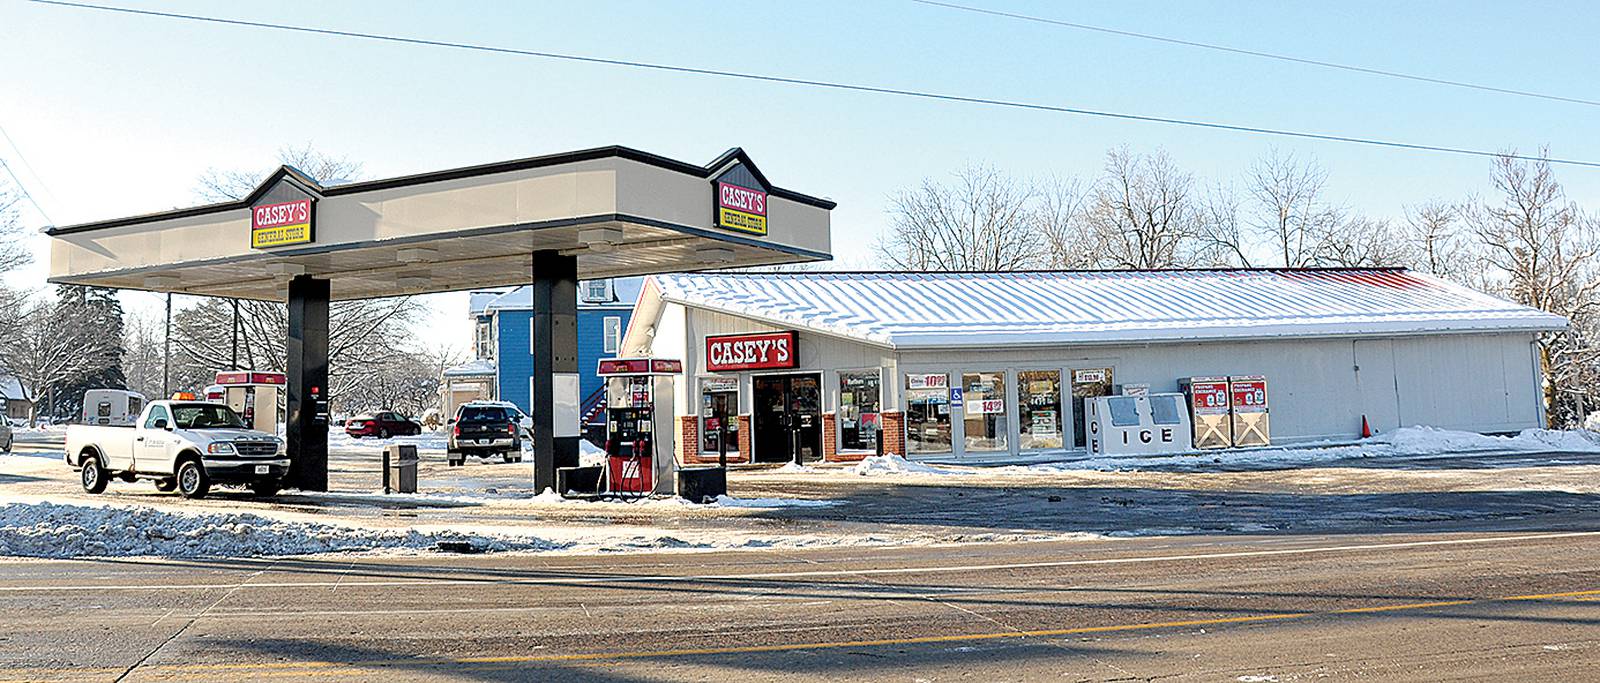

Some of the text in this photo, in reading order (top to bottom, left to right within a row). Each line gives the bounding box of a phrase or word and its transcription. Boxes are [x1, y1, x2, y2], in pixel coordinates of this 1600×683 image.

[722, 185, 763, 213] CASEY'S
[256, 202, 307, 226] CASEY'S
[286, 227, 304, 240] STORE
[710, 338, 789, 365] CASEY'S
[1090, 402, 1099, 453] ICE
[1122, 428, 1173, 445] ICE
